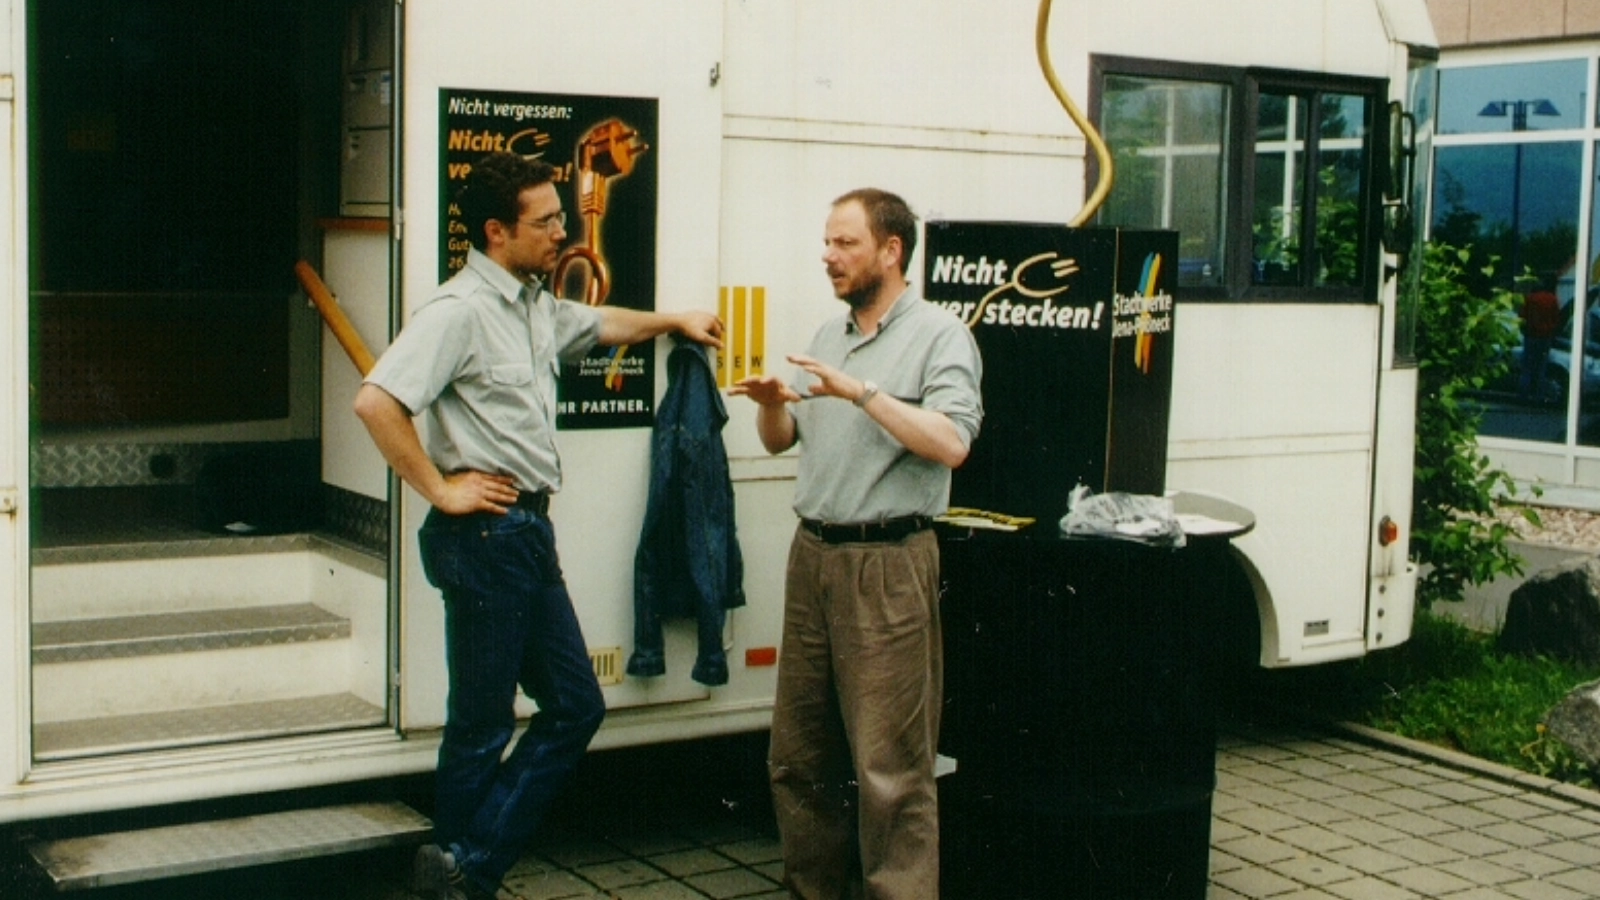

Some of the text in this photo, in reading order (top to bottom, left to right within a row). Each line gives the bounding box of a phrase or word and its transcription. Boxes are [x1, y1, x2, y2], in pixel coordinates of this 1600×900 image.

[448, 97, 573, 121] Nicht vergessen:
[448, 129, 505, 152] Nicht
[448, 162, 472, 179] ve
[932, 255, 1008, 286] Nicht
[982, 299, 1104, 330] stecken!
[557, 400, 650, 414] HR PARTNER.
